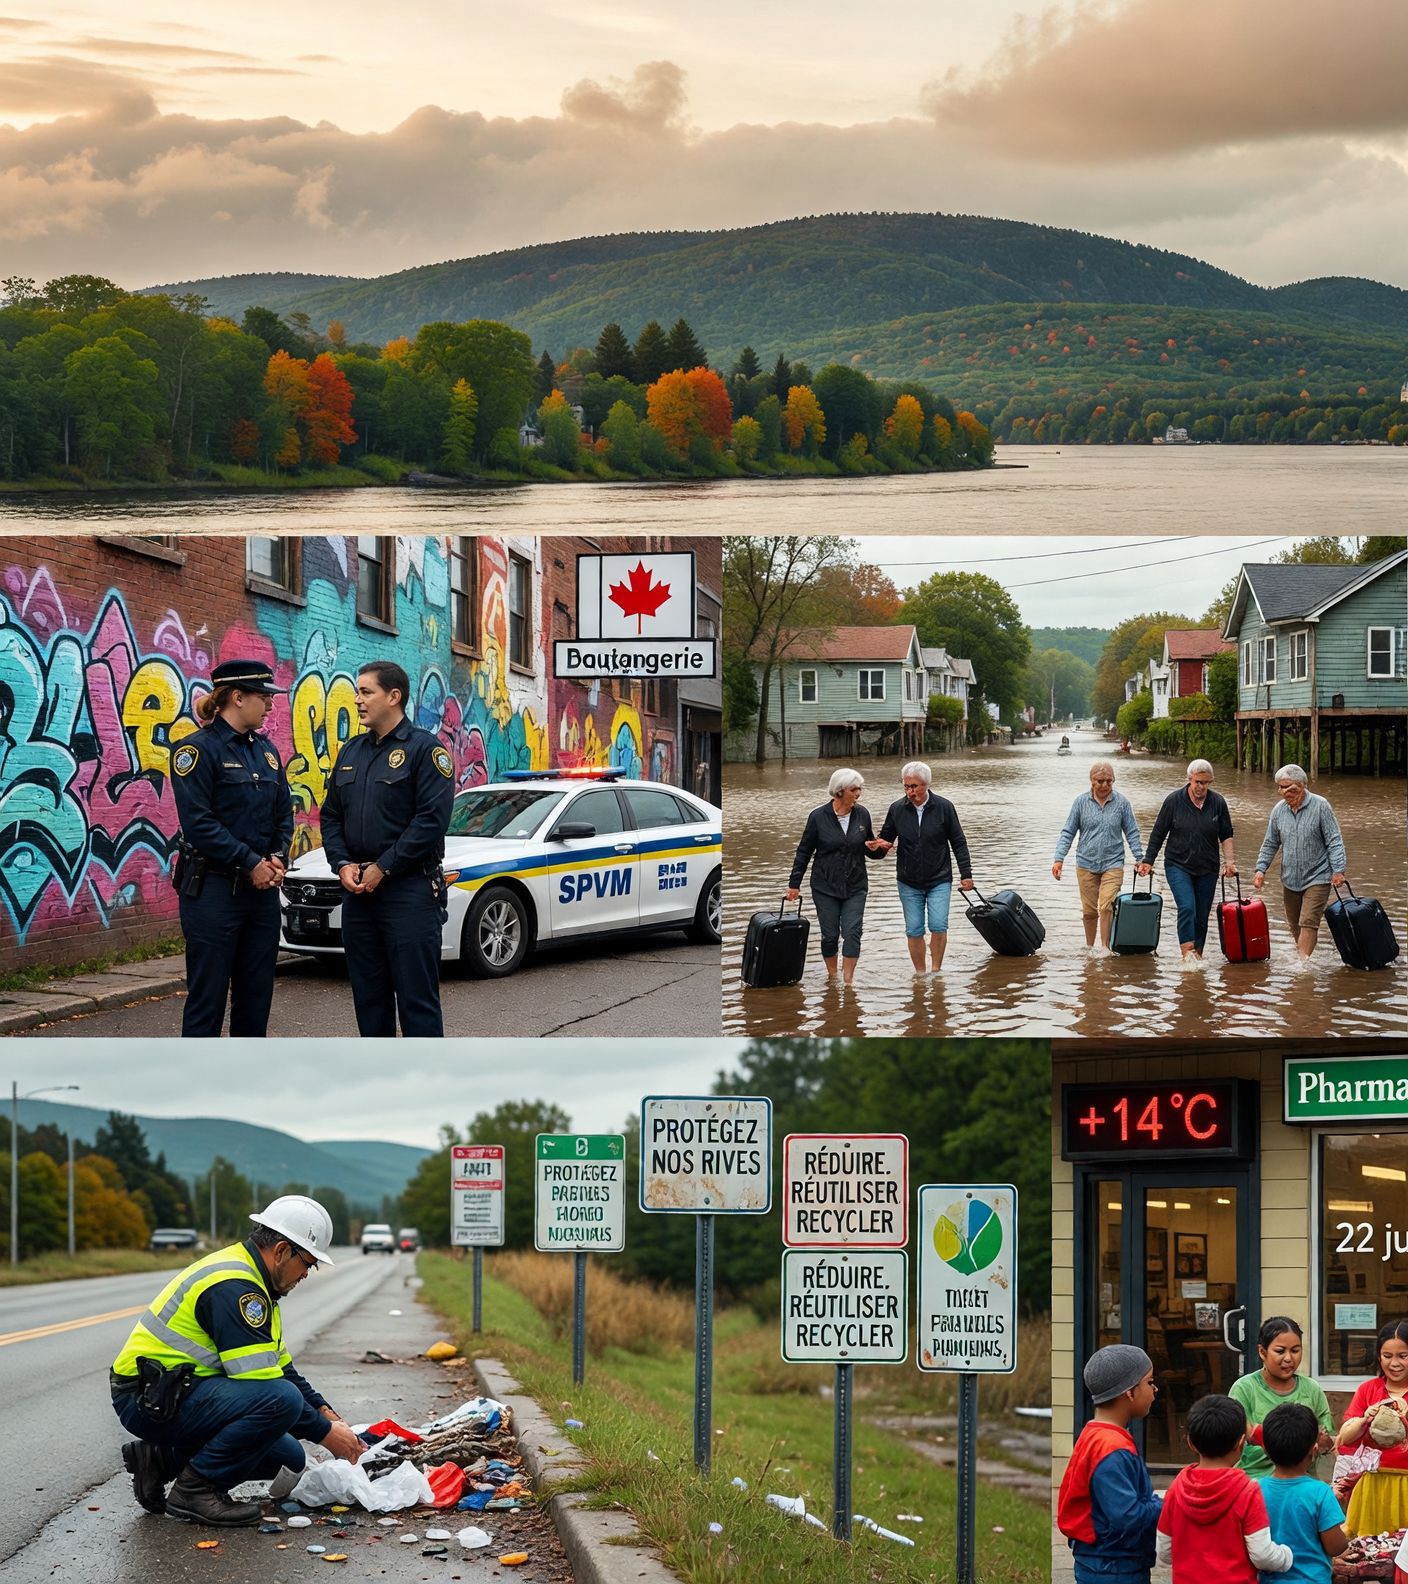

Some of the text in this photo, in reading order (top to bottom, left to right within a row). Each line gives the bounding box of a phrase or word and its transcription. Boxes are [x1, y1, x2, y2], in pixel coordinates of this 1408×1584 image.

[558, 867, 632, 904] SPVM
[652, 1113, 759, 1144] PROTÉGEZ
[652, 1149, 761, 1176] NOS RIVES
[796, 1209, 894, 1234] RECYCLER
[789, 1290, 899, 1319] RÉUTILISER
[796, 1323, 894, 1348] RECYCLER
